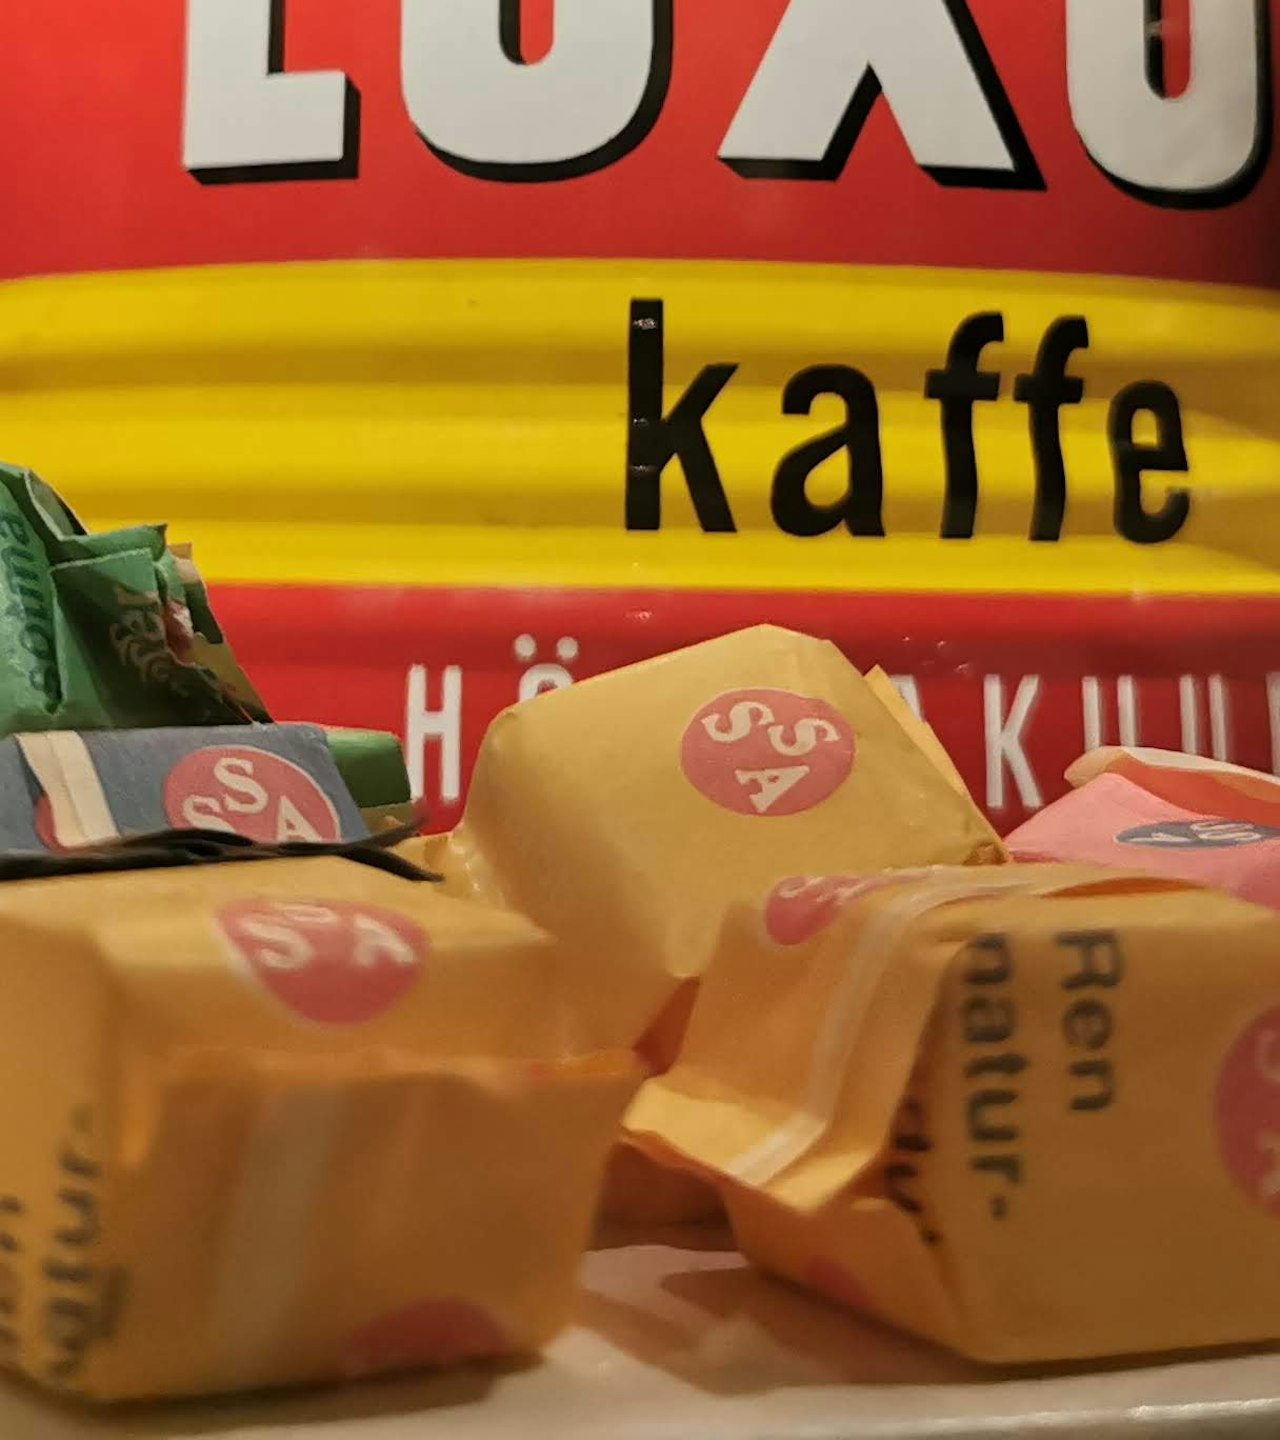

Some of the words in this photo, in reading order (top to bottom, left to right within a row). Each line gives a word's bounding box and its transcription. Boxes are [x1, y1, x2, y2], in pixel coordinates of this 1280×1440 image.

[623, 297, 1193, 545] kaffe
[960, 931, 1033, 1223] natur-
[1050, 928, 1127, 1115] Ren
